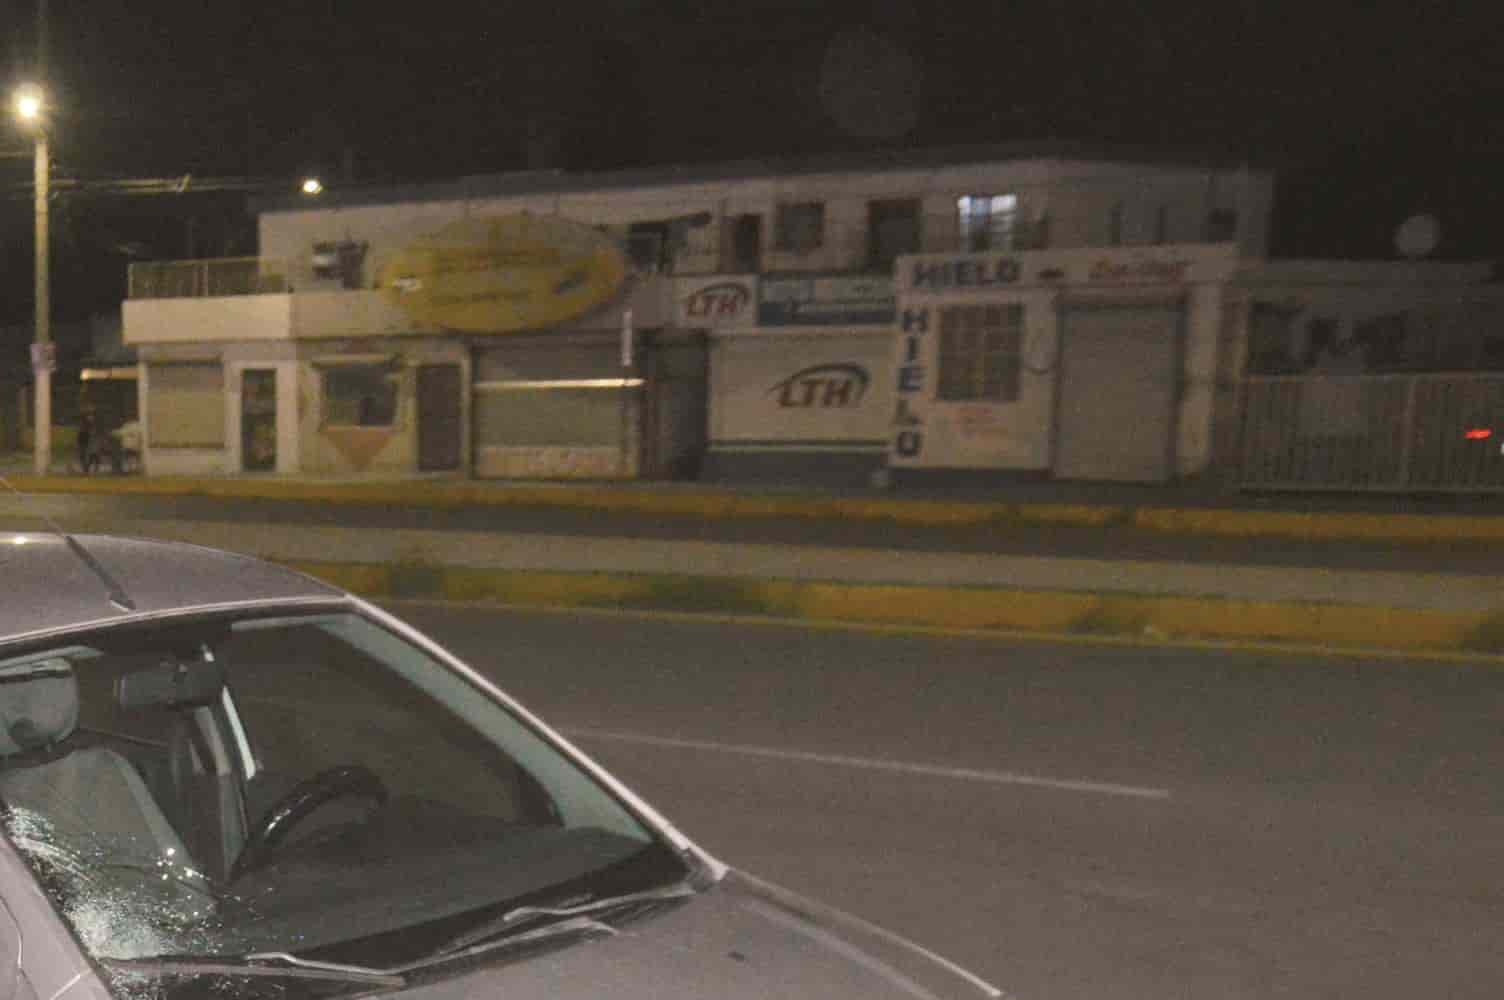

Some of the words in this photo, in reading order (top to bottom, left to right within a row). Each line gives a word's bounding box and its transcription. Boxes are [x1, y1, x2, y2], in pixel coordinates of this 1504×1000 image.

[912, 260, 1022, 287] HIELO
[686, 293, 739, 316] LTH
[776, 376, 851, 409] LTH
